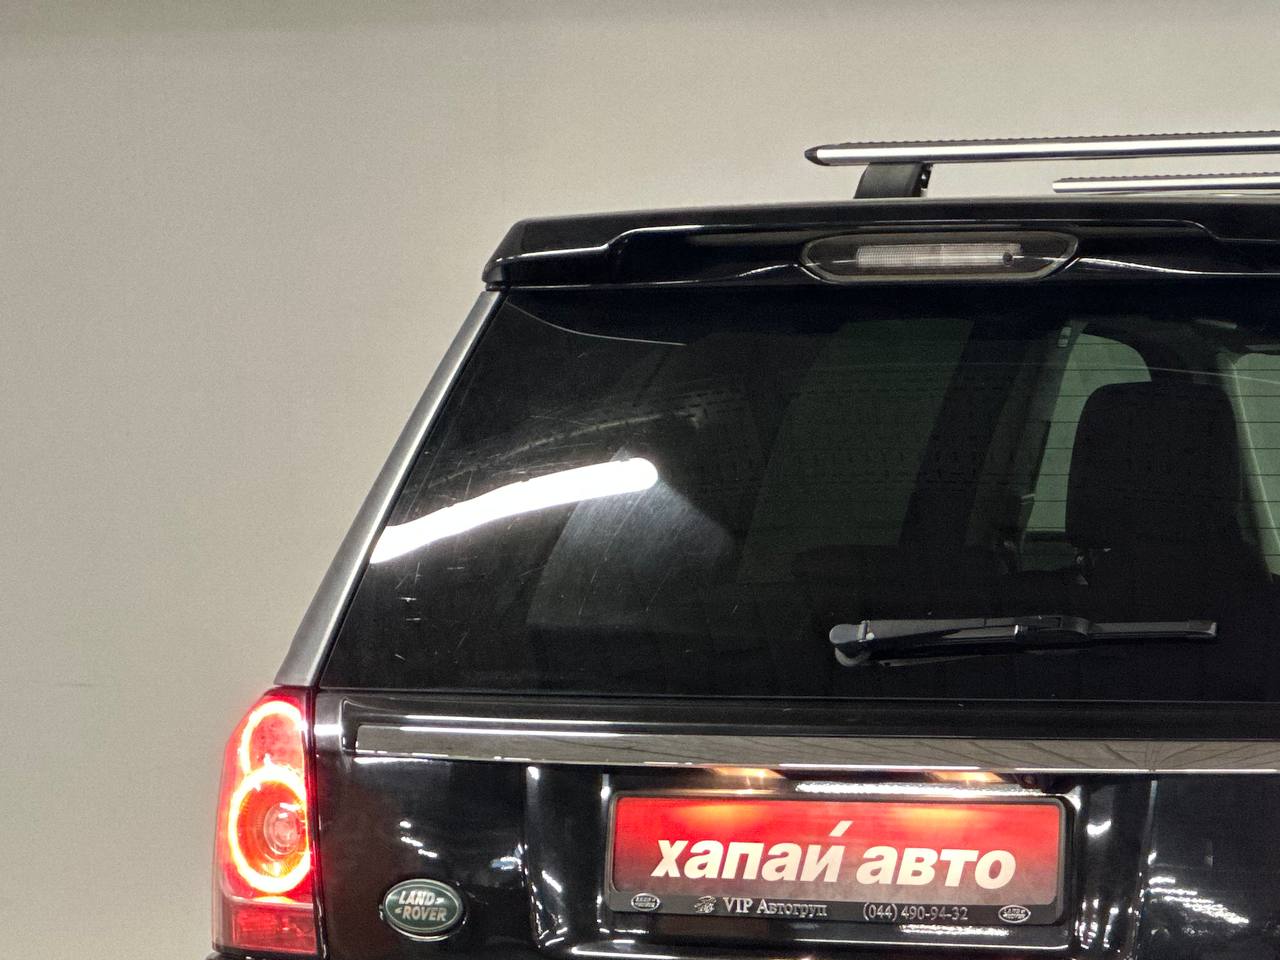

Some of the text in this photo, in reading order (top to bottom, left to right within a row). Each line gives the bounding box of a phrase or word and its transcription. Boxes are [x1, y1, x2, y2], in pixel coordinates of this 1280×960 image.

[855, 844, 1017, 890] авто
[398, 889, 436, 906] LAND
[723, 896, 753, 914] VIP
[402, 906, 448, 921] ROVER
[863, 902, 969, 922] (044) 490-94-32
